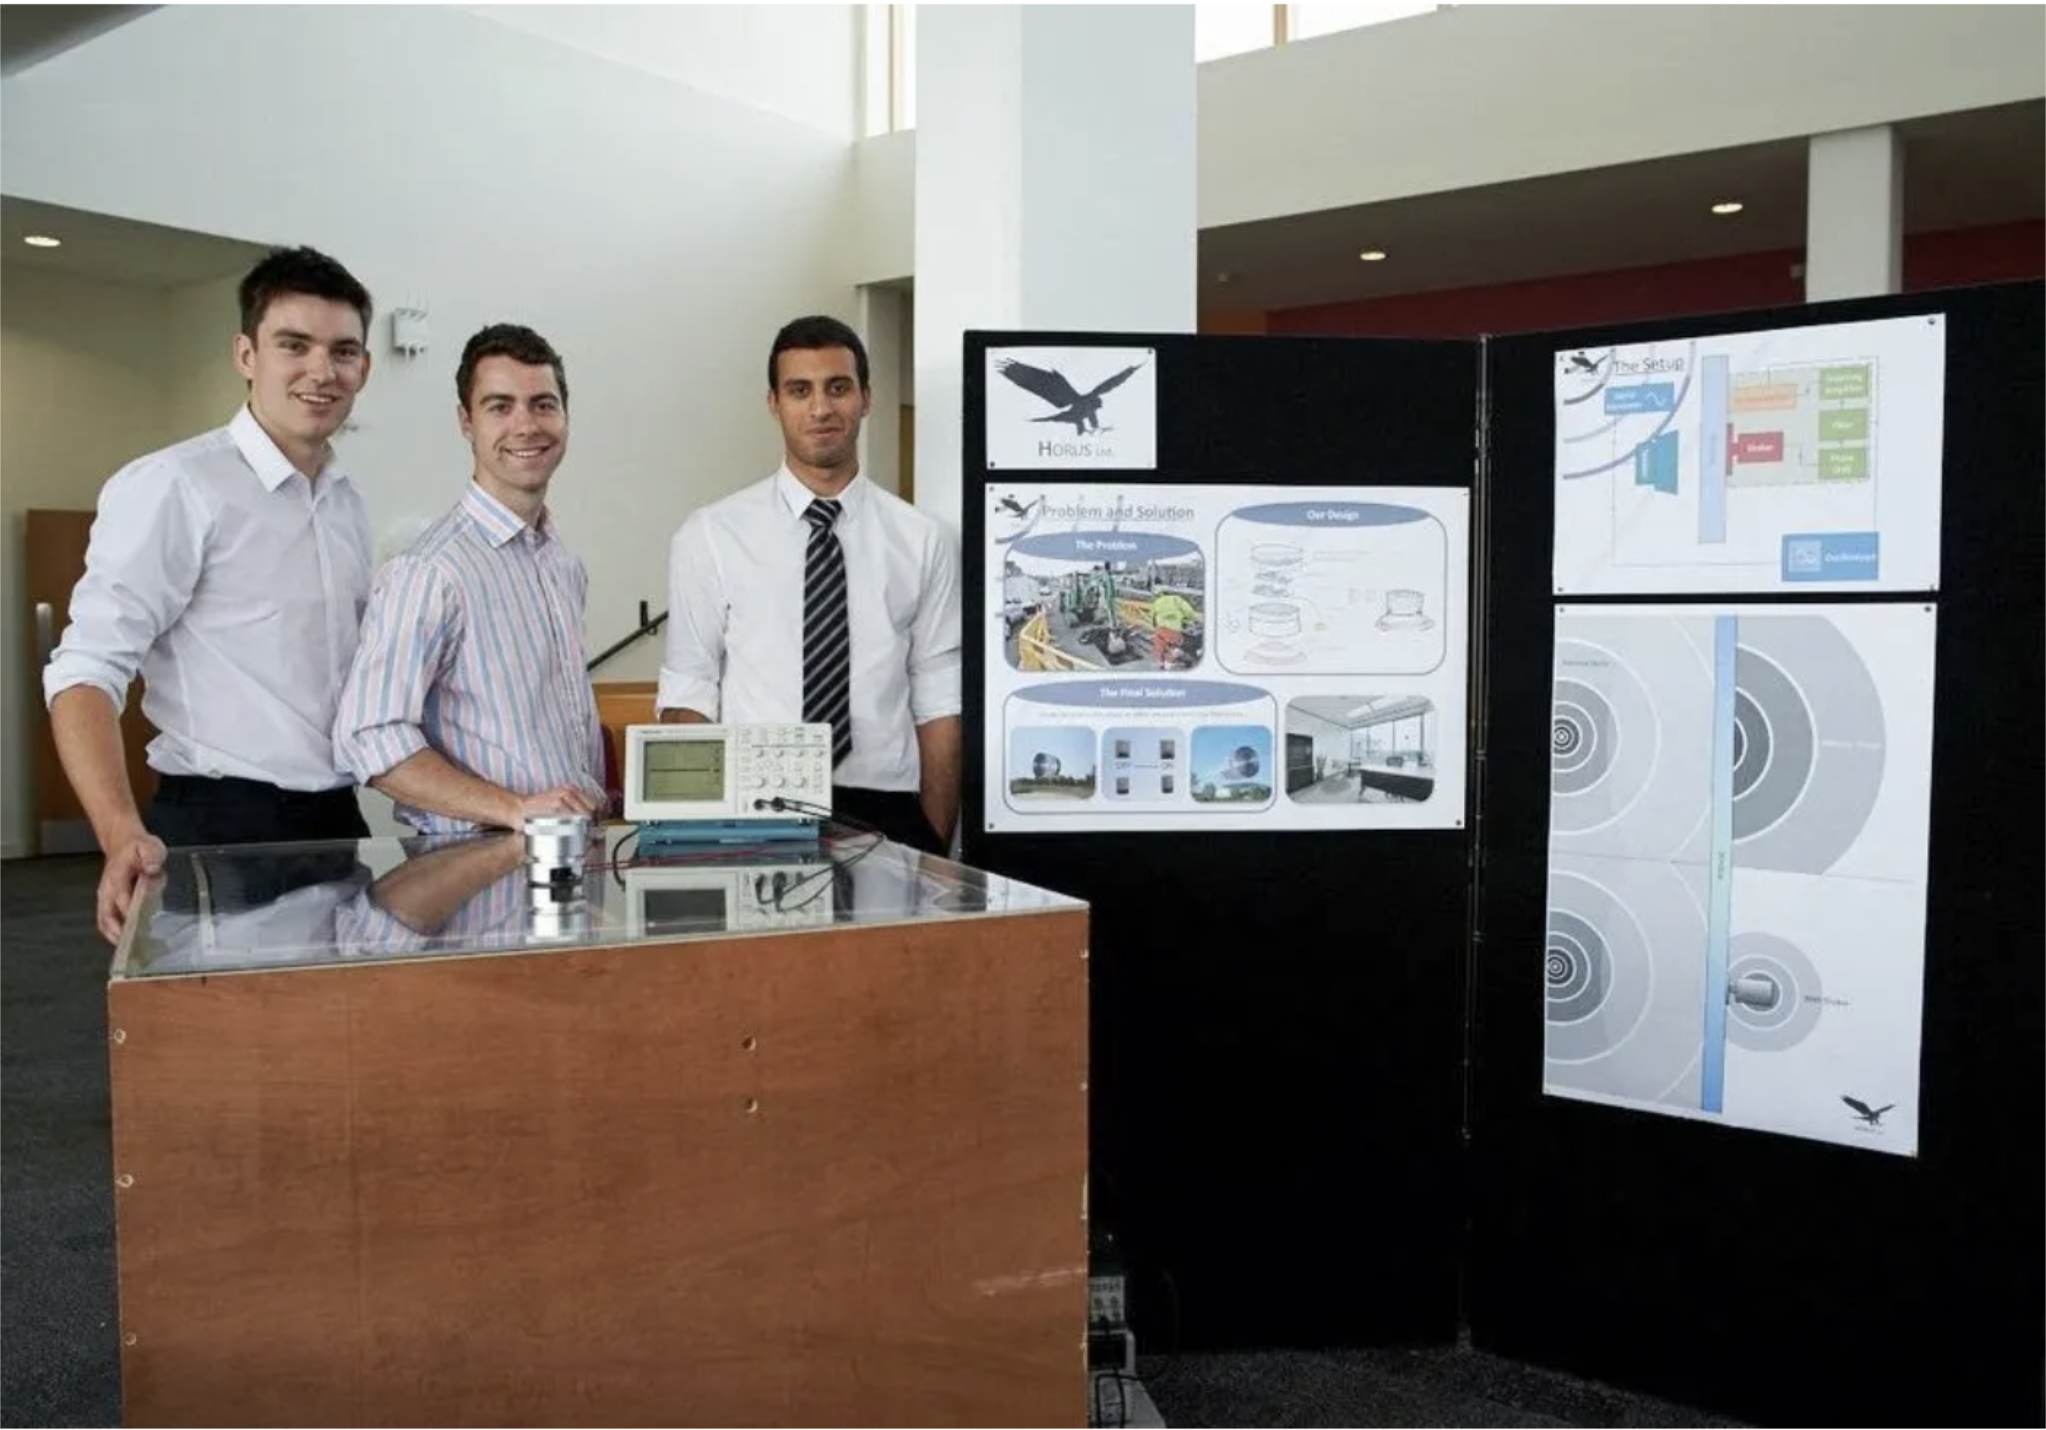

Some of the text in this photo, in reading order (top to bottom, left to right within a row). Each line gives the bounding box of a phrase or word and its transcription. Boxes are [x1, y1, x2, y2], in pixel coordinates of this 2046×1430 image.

[1613, 357, 1684, 374] The Setup
[1042, 503, 1195, 519] Problem and Solution
[1075, 540, 1138, 550] The Problem
[1099, 688, 1118, 698] The
